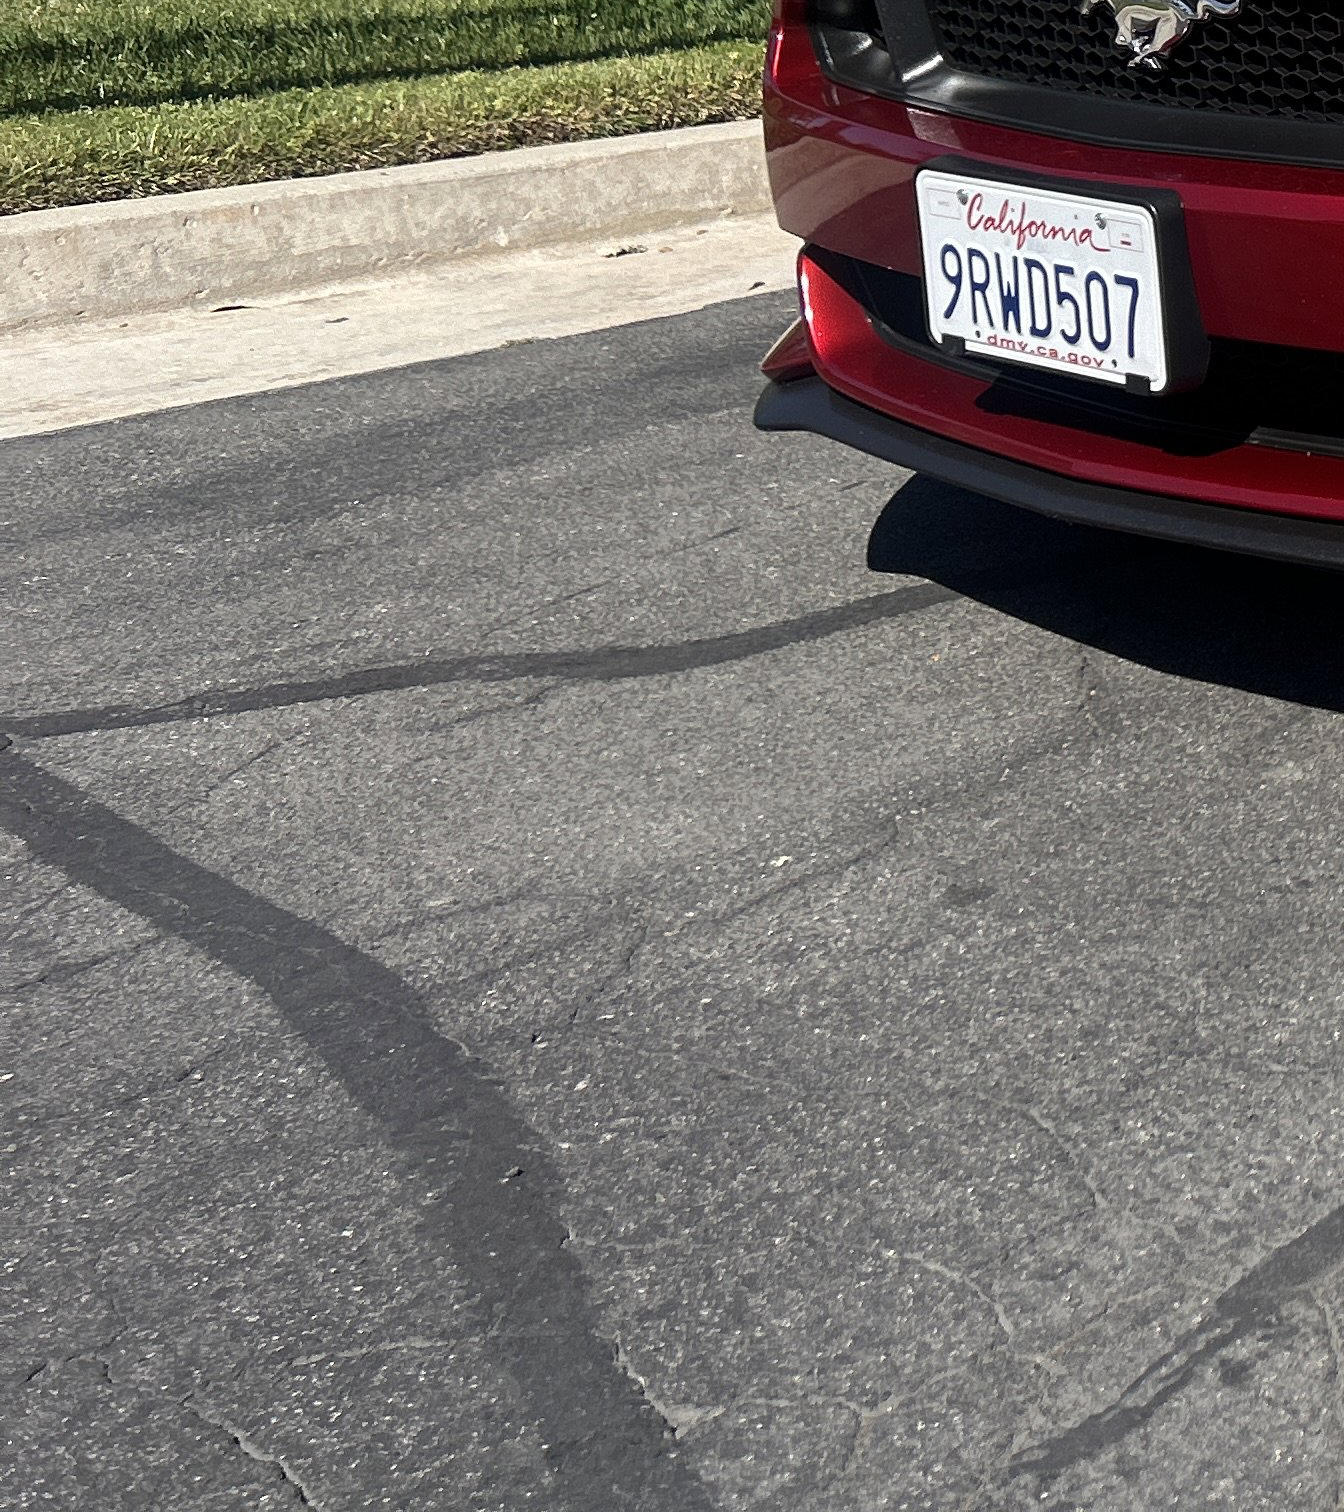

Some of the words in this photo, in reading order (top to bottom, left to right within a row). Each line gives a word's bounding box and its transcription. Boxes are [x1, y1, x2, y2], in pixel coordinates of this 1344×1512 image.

[966, 192, 1111, 251] California
[940, 243, 1140, 359] 9RWD507
[986, 333, 1105, 369] dmv.ca.gov
